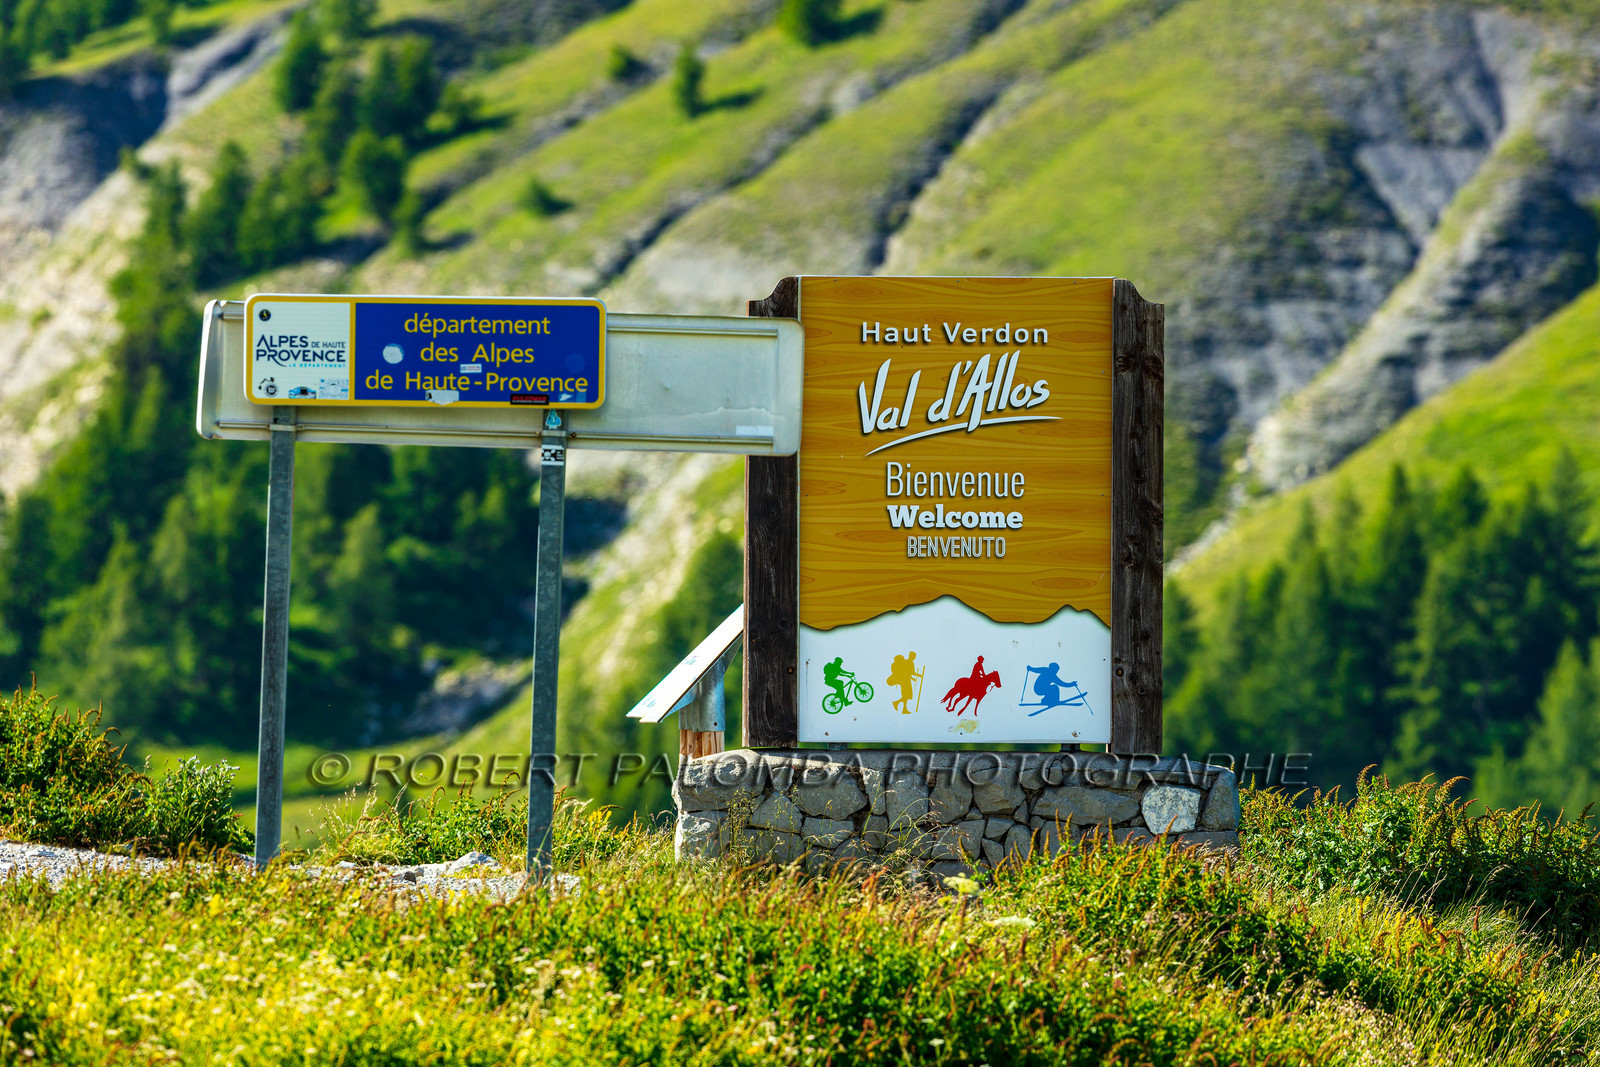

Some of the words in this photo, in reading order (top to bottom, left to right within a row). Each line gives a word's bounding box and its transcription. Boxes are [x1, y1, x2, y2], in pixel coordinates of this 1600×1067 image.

[403, 312, 551, 338] département
[861, 321, 932, 344] Haut
[942, 322, 1049, 344] Verdon
[256, 334, 308, 349] ALPES
[322, 341, 347, 349] HAUTE
[256, 349, 346, 364] PROVENCE
[419, 341, 459, 362] des
[471, 342, 535, 368] Alpes
[364, 369, 394, 390] de
[405, 371, 589, 393] Haute-Provence
[858, 358, 922, 434] Val
[927, 349, 1051, 433] d'Allos
[886, 461, 1025, 498] Bienvenue
[886, 503, 1024, 529] Welcome
[907, 535, 1006, 558] BENVENUTO
